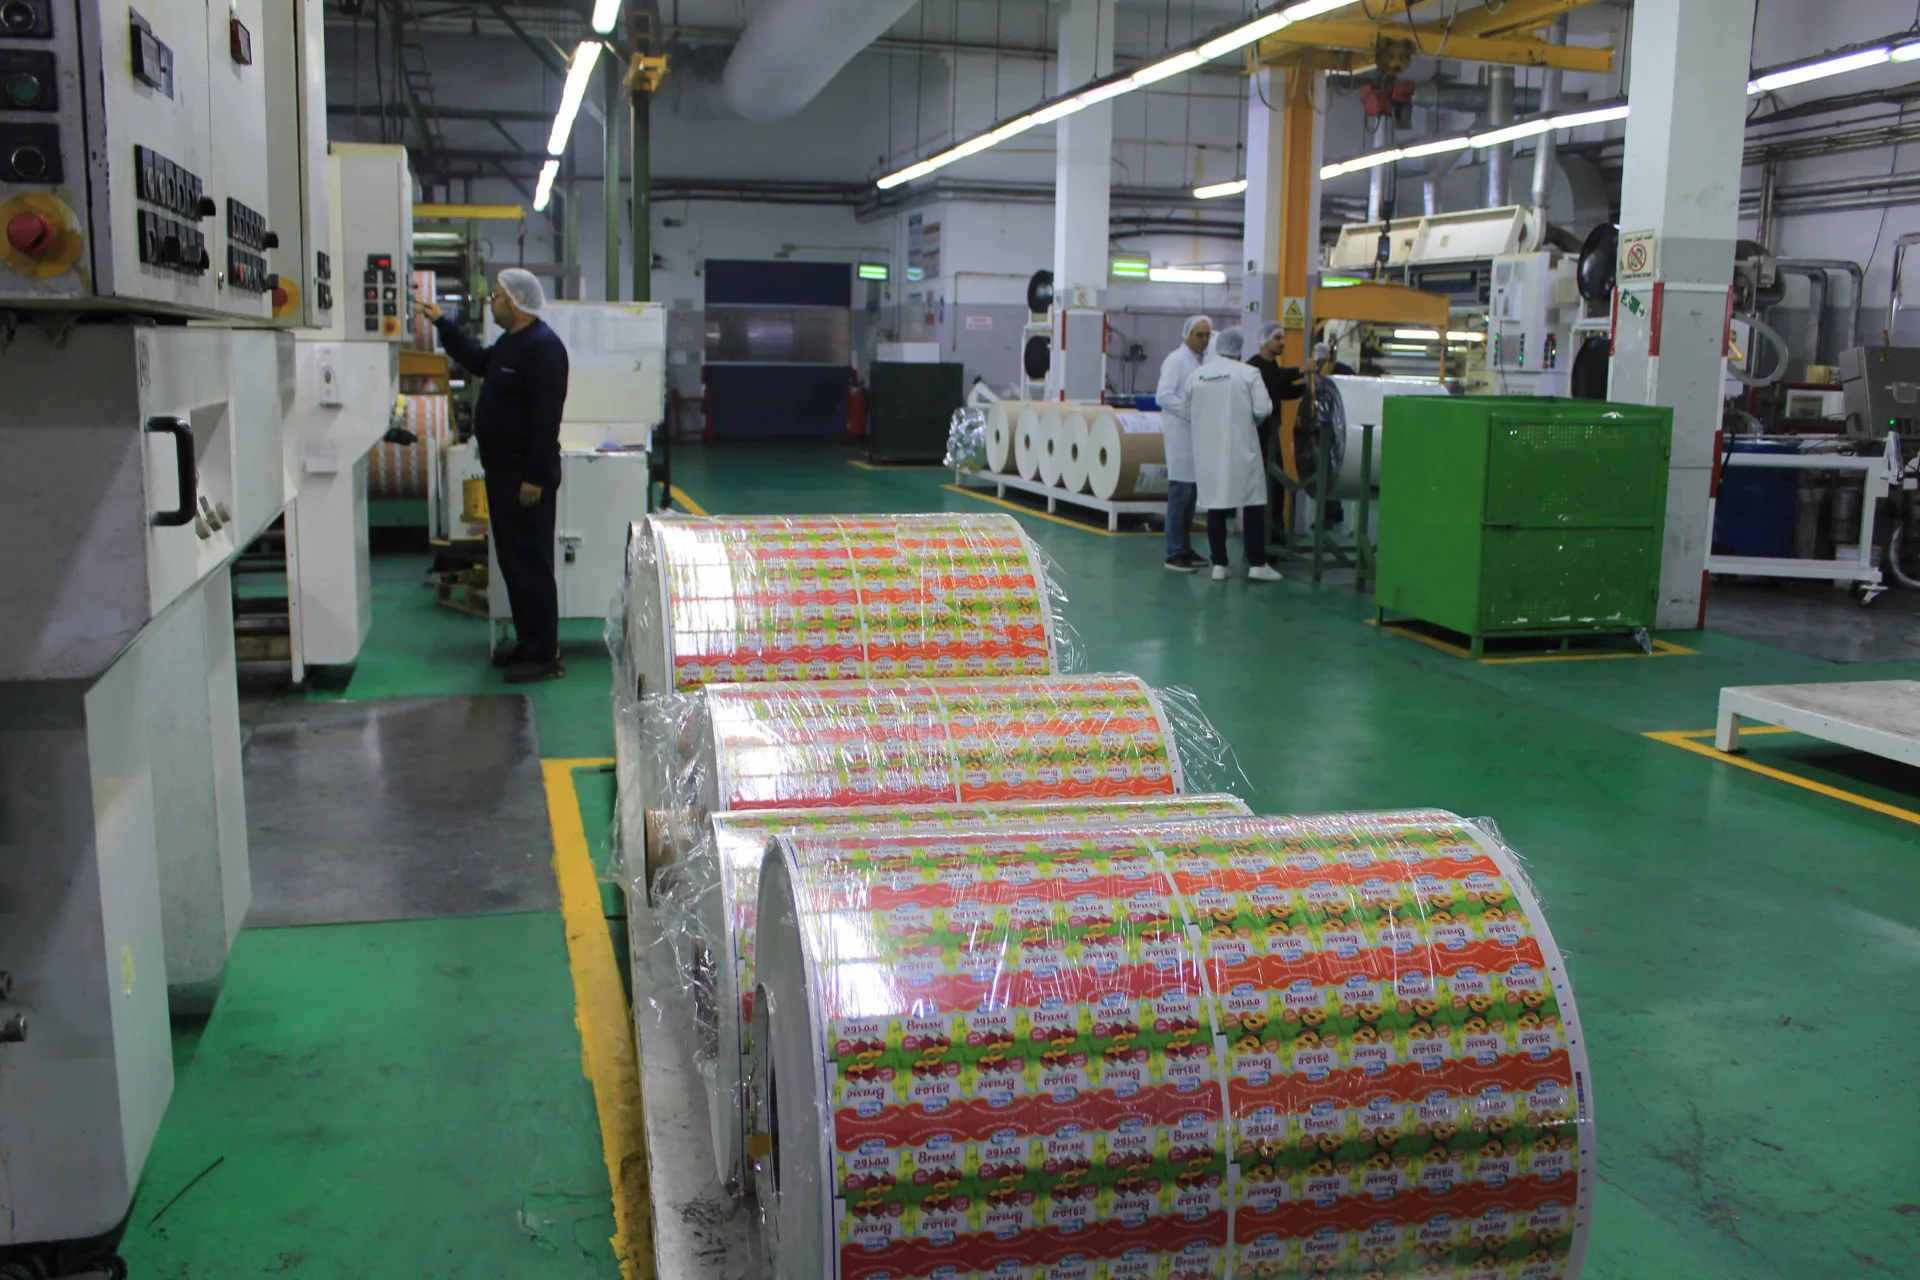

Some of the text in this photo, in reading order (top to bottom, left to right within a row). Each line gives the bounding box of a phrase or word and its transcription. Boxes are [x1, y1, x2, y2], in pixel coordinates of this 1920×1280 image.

[1505, 976, 1536, 987] Brassé
[1397, 984, 1430, 996] Brassé
[1285, 992, 1318, 1004] Brassé
[1157, 1002, 1191, 1014] Brassé
[1034, 1012, 1069, 1023] Brassé
[907, 1019, 943, 1031] Brassé
[1466, 1038, 1497, 1050] Brassé
[1355, 1048, 1387, 1060] Brassé
[1238, 1058, 1271, 1071] Brassé
[1105, 1069, 1140, 1080] Brassé
[978, 1078, 1014, 1092] Brassé
[847, 1088, 884, 1102] Brassé
[1174, 1129, 1208, 1142] Brassé
[1048, 1140, 1084, 1153] Brassé
[918, 1150, 955, 1163] Brassé
